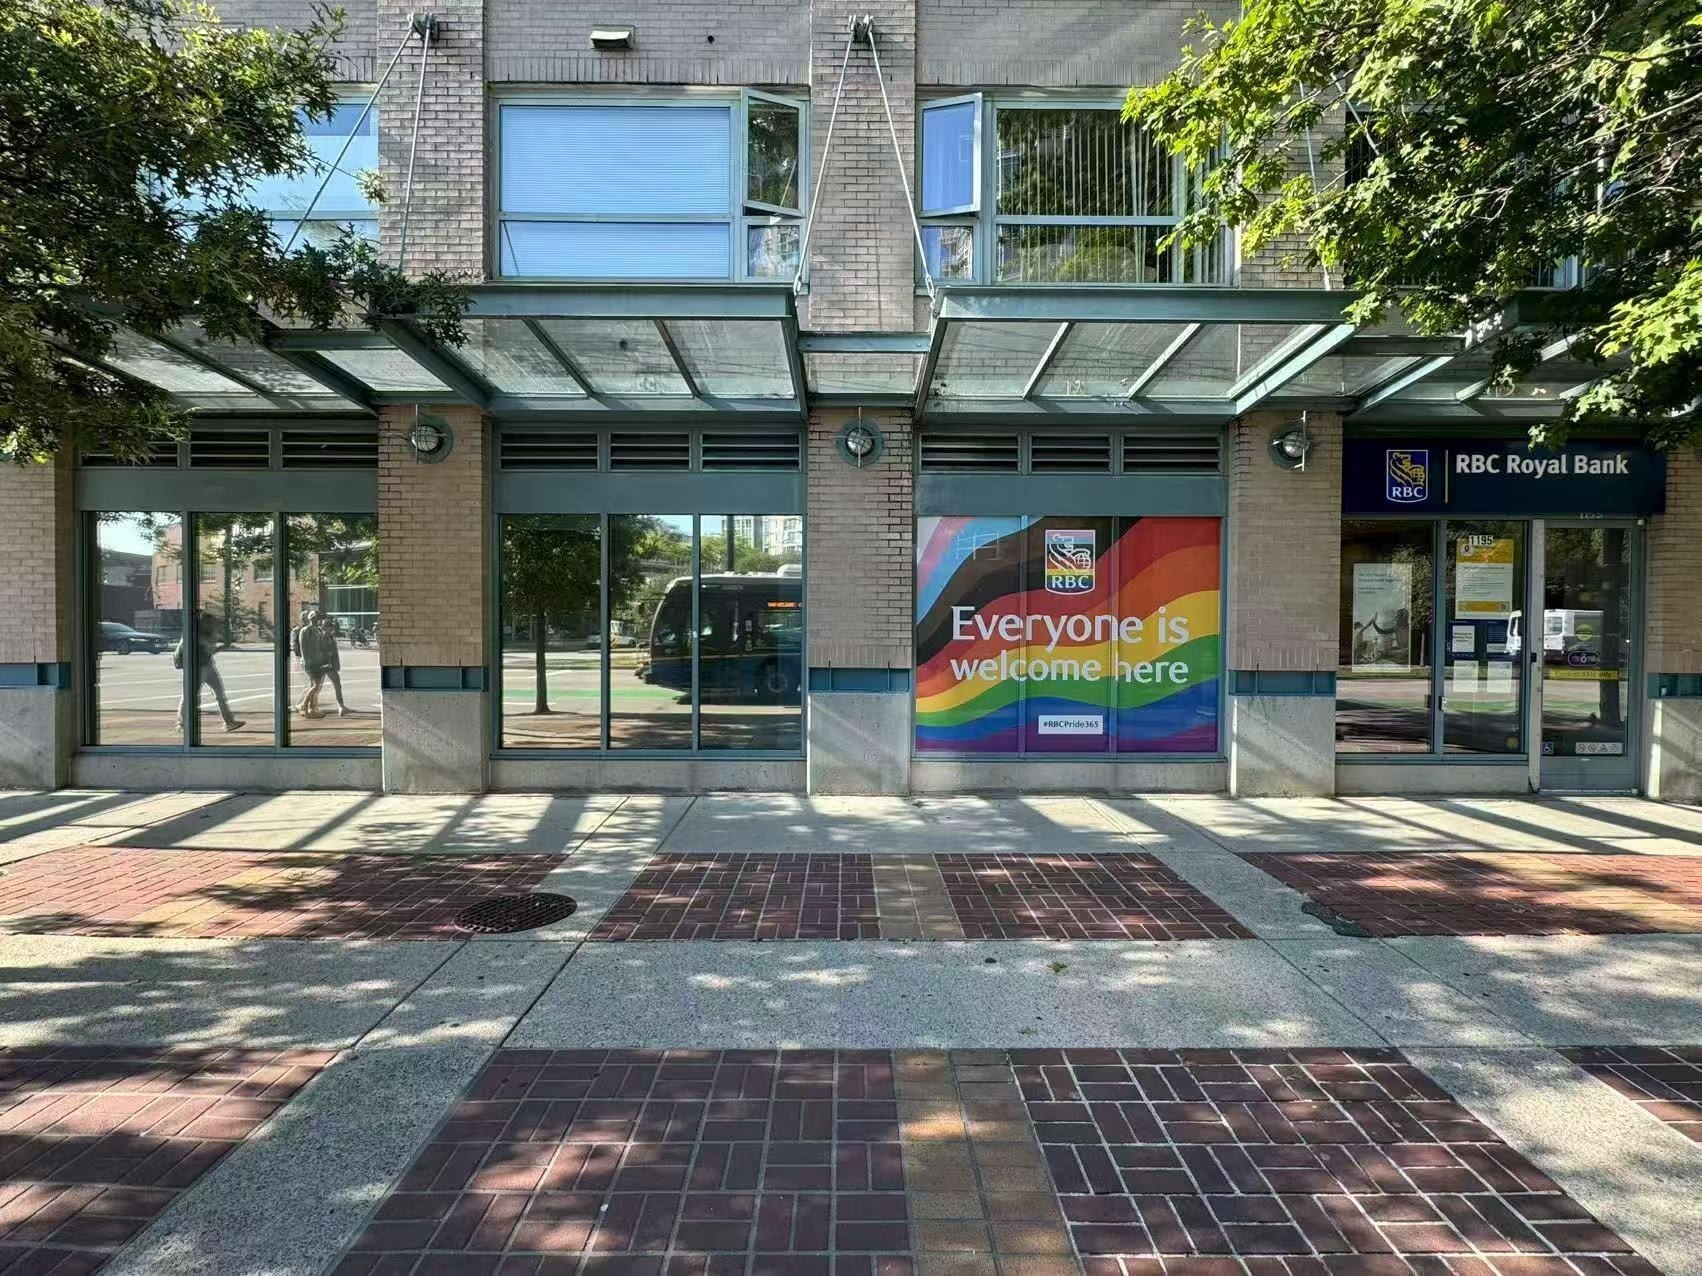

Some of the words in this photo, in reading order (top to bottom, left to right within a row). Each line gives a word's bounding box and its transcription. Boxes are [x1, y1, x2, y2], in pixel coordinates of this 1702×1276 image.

[1455, 454, 1500, 474] RBC
[1506, 454, 1568, 479] Royal
[1573, 455, 1629, 474] Bank
[1391, 486, 1424, 499] RBC
[1471, 535, 1494, 545] 1195
[1051, 575, 1089, 589] RBC
[951, 606, 1144, 652] Everyone
[1158, 606, 1190, 644] is
[950, 649, 1102, 682] welcome
[1114, 651, 1189, 684] here
[1043, 720, 1099, 729] #RBCPride365
